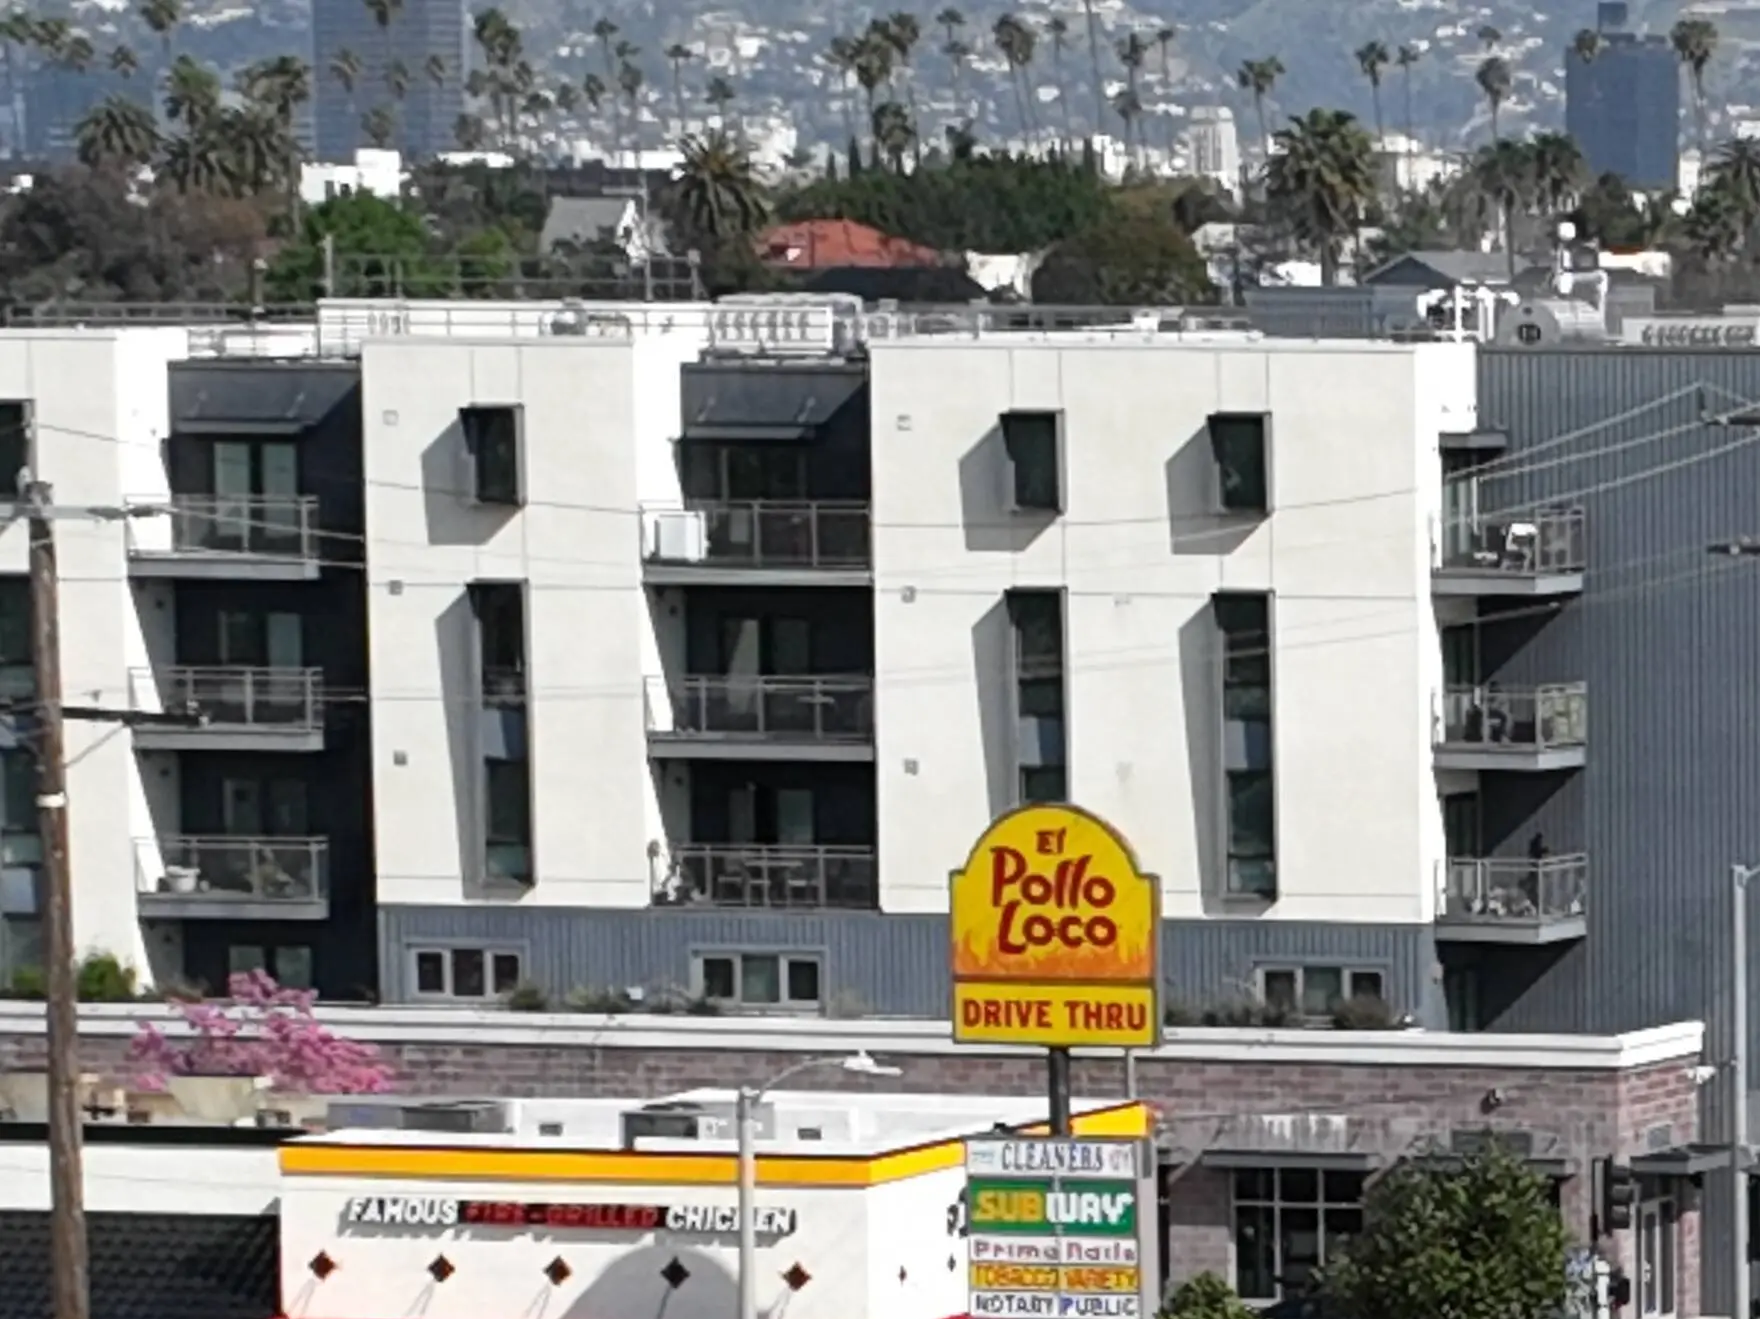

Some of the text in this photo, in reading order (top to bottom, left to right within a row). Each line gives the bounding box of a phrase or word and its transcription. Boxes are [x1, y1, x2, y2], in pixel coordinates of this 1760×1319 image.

[1036, 827, 1067, 854] El
[990, 846, 1115, 909] Pollo
[999, 900, 1117, 954] Loco
[963, 998, 1146, 1030] DRIVE THRU
[1002, 1143, 1103, 1171] CLEANERS
[349, 1198, 457, 1224] FAMOUS
[464, 1203, 659, 1228] FIRE-GRILLED
[973, 1190, 1133, 1225] SUBWAY
[976, 1295, 1137, 1316] NOTARY PUBLIC
